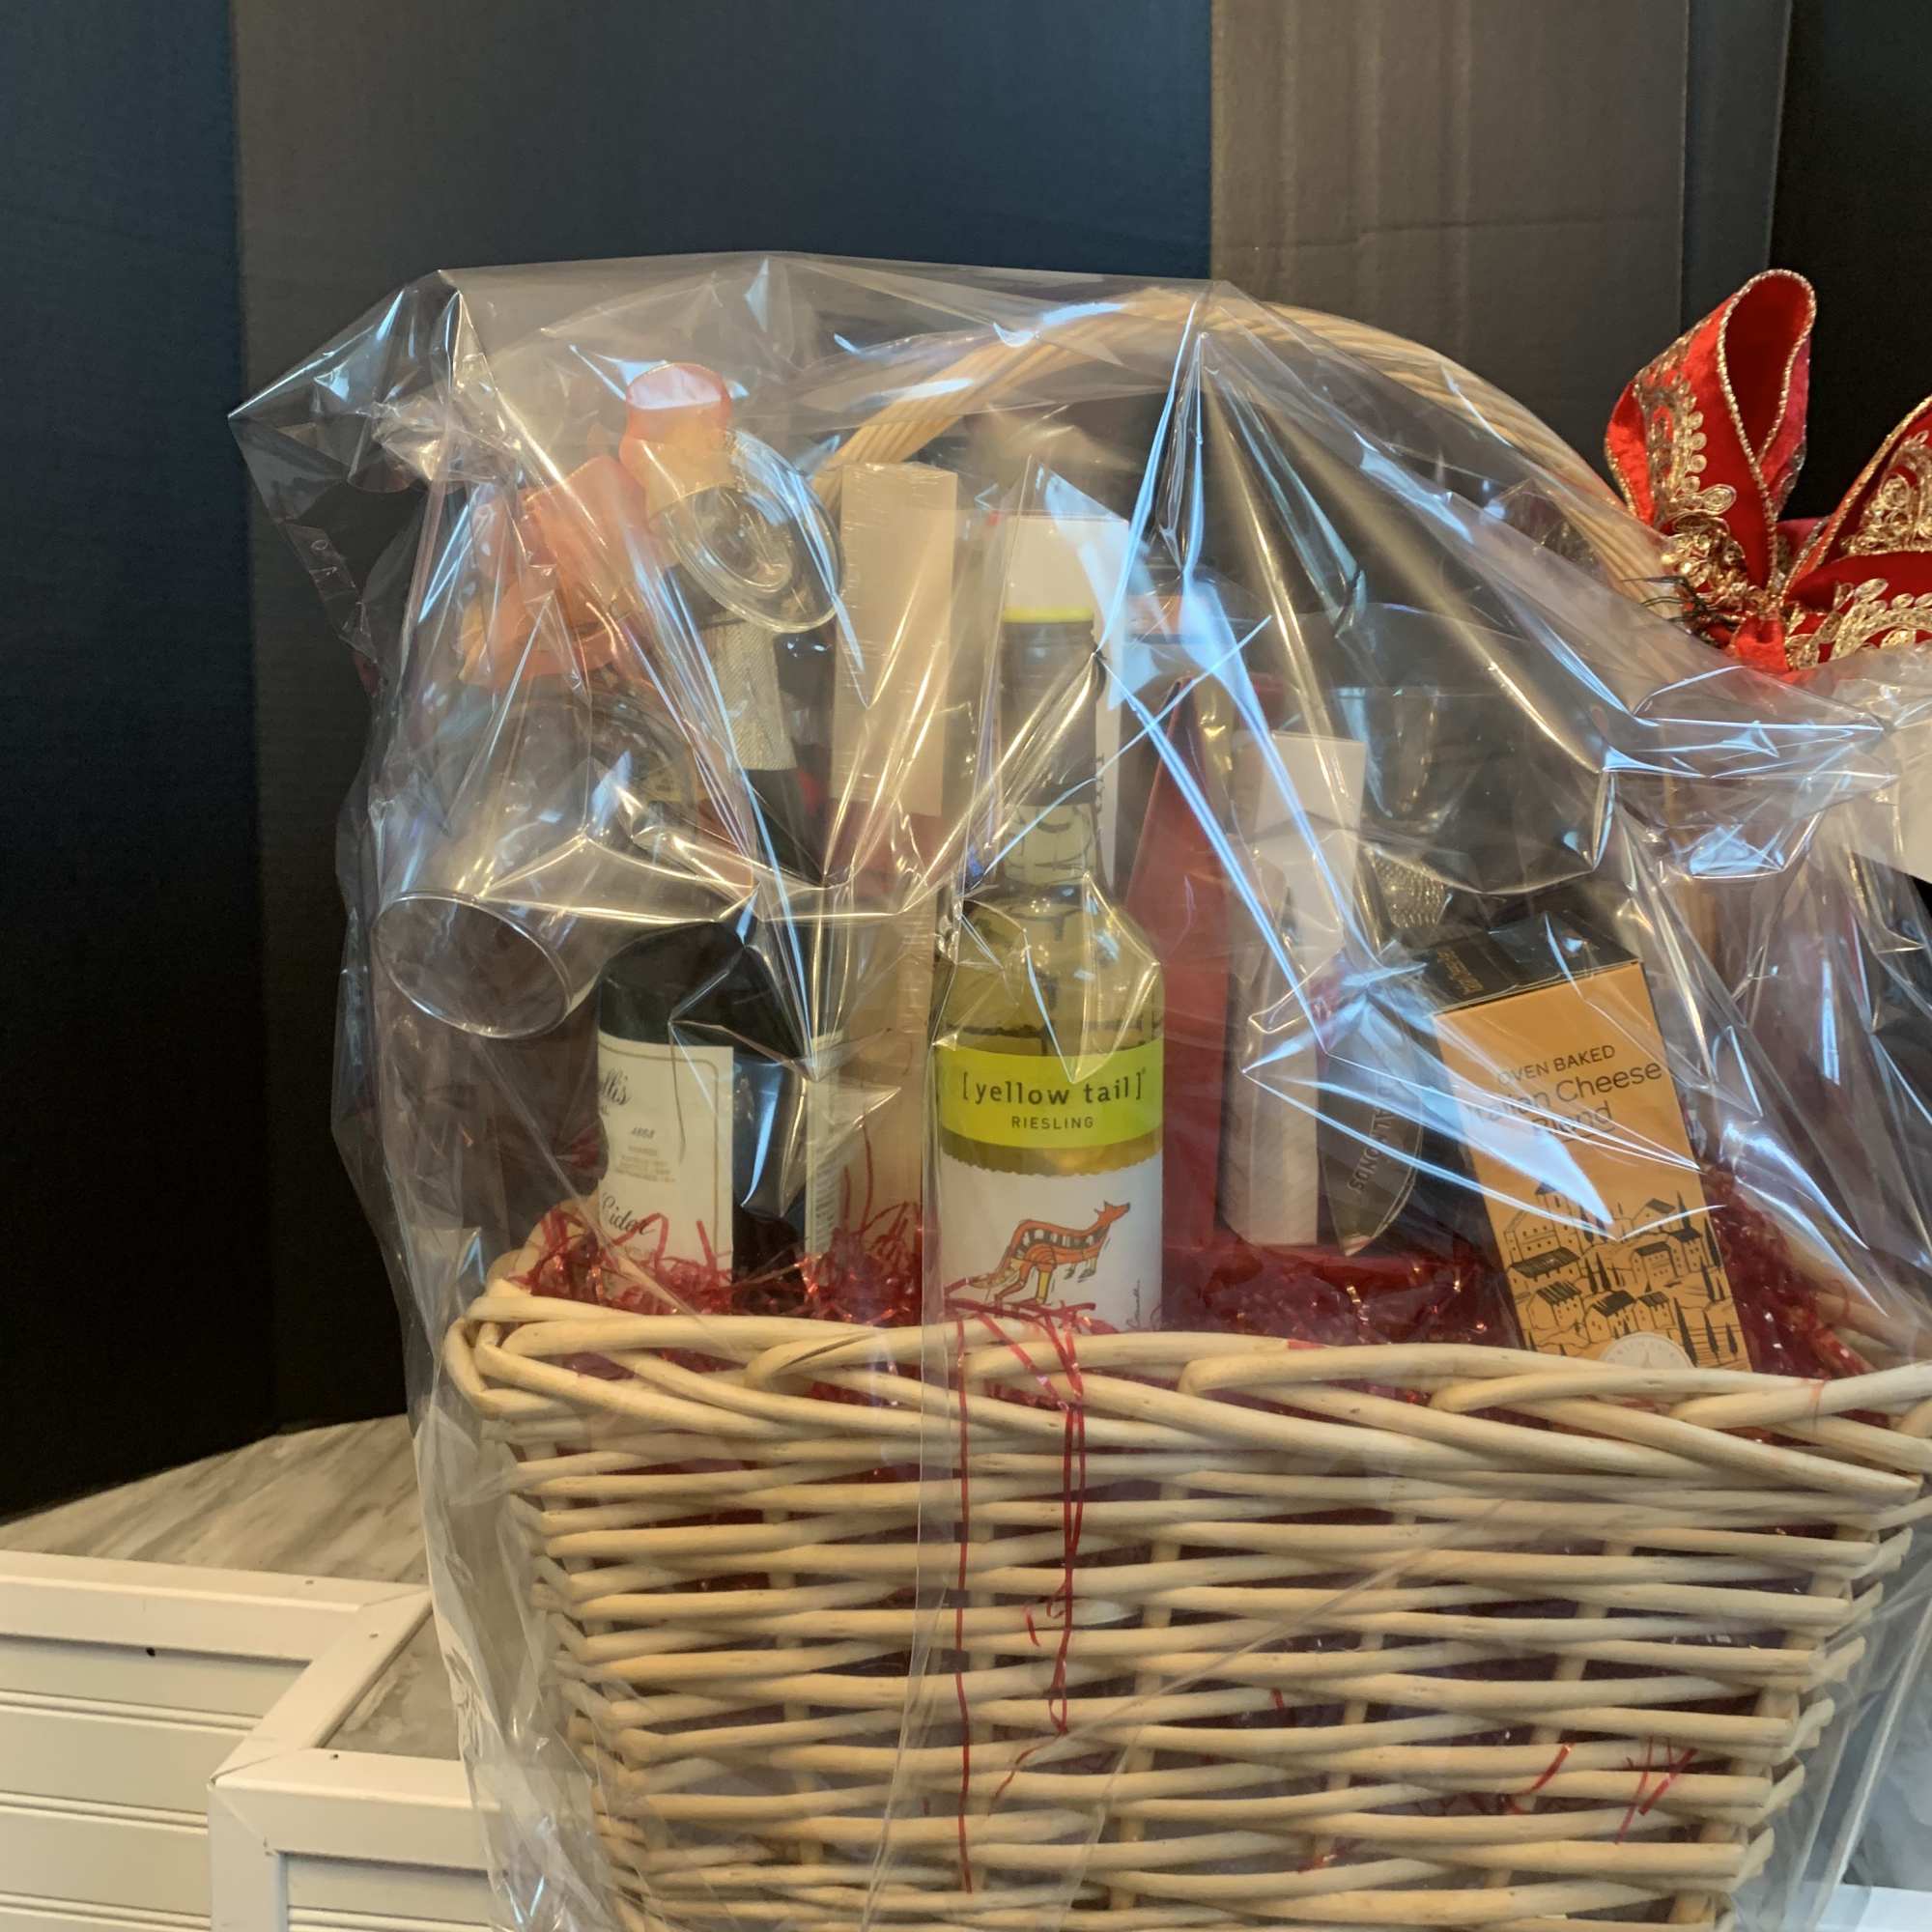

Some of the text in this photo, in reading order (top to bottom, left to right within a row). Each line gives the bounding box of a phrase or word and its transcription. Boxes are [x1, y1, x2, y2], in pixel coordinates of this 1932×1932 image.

[1497, 1044, 1615, 1085] OVEN BAKED
[1555, 1062, 1662, 1102] Cheese
[1011, 1115, 1094, 1130] RIESLING
